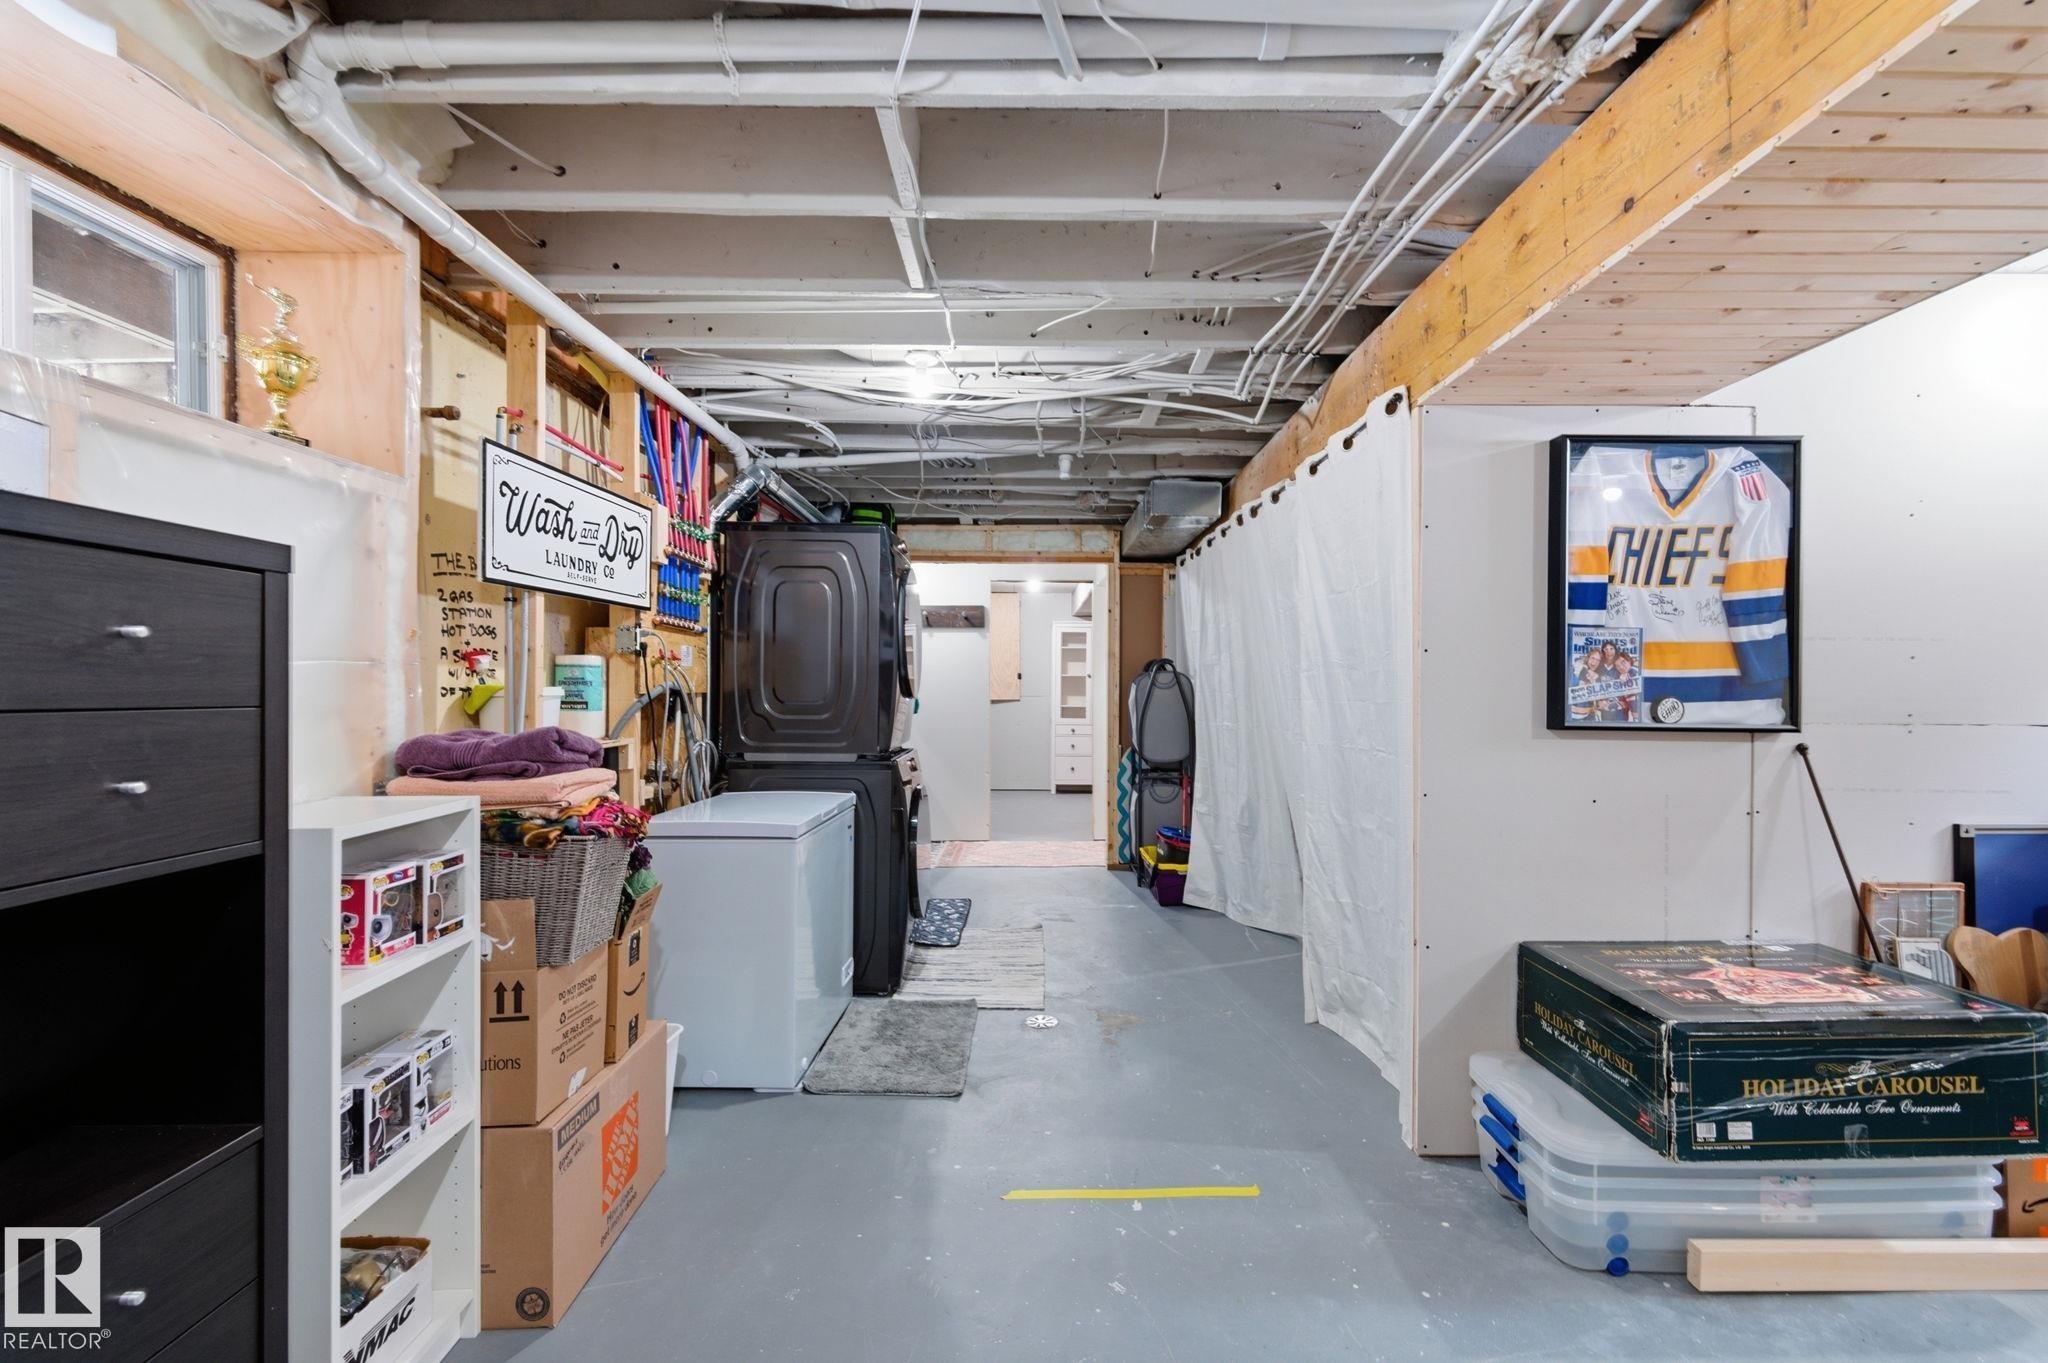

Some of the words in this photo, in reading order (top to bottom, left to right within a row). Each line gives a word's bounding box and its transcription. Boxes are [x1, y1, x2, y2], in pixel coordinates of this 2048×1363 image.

[499, 480, 577, 542] Wash
[580, 523, 599, 541] and
[599, 514, 644, 569] Dry
[431, 552, 465, 571] THE
[546, 549, 598, 575] LAUNDRY
[437, 588, 447, 602] 2
[449, 590, 474, 604] GAS
[441, 607, 492, 621] STATION
[441, 624, 466, 638] HOT
[469, 623, 497, 640] DOGS
[1534, 1001, 1574, 1038] HOLIDAY
[1577, 1030, 1638, 1080] CAROUSEL
[1742, 1077, 1847, 1098] HOLIDAY
[1857, 1075, 1985, 1097] CAROUSEL
[1769, 1101, 1799, 1117] With
[1803, 1100, 1861, 1117] Collectable
[1865, 1100, 1895, 1115] Tree
[1900, 1099, 1962, 1115] Ornaments
[560, 1097, 598, 1144] MEDIUM
